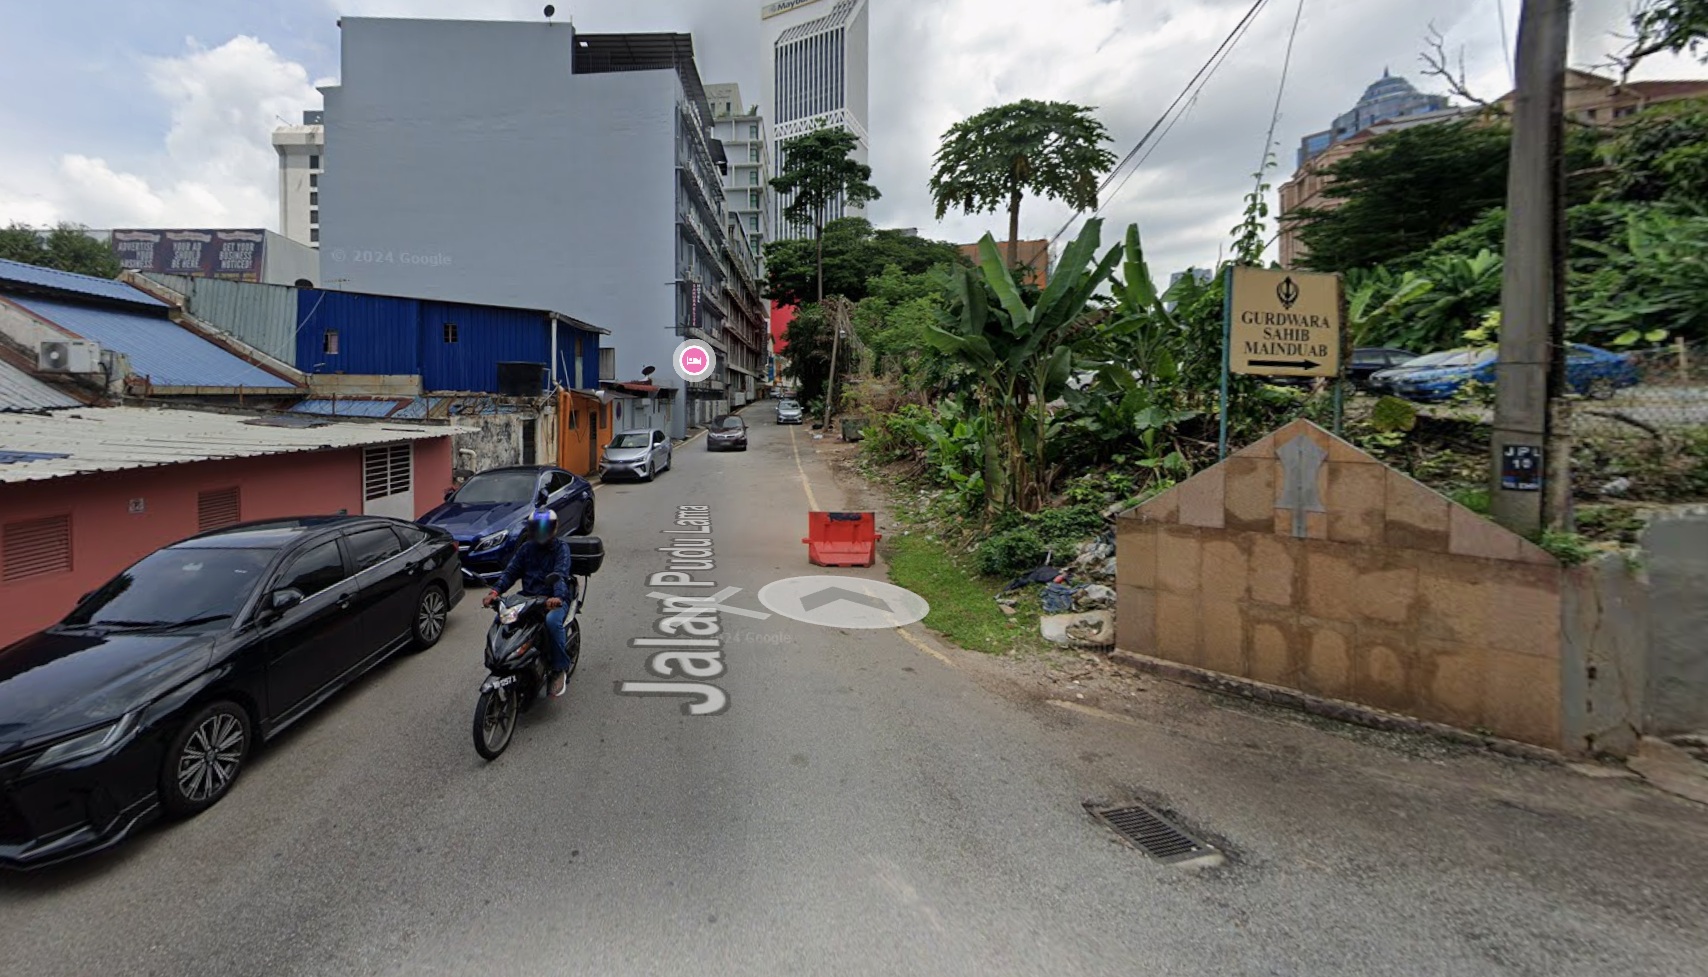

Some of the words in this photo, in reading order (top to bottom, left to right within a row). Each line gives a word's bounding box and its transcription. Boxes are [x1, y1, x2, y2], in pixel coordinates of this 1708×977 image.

[222, 242, 235, 251] GET
[237, 242, 255, 251] YOUR
[219, 251, 252, 260] BUSINESS
[1241, 310, 1331, 328] GURDWARA
[1263, 327, 1310, 341] SAHIB
[1244, 341, 1328, 357] MAINDUAB
